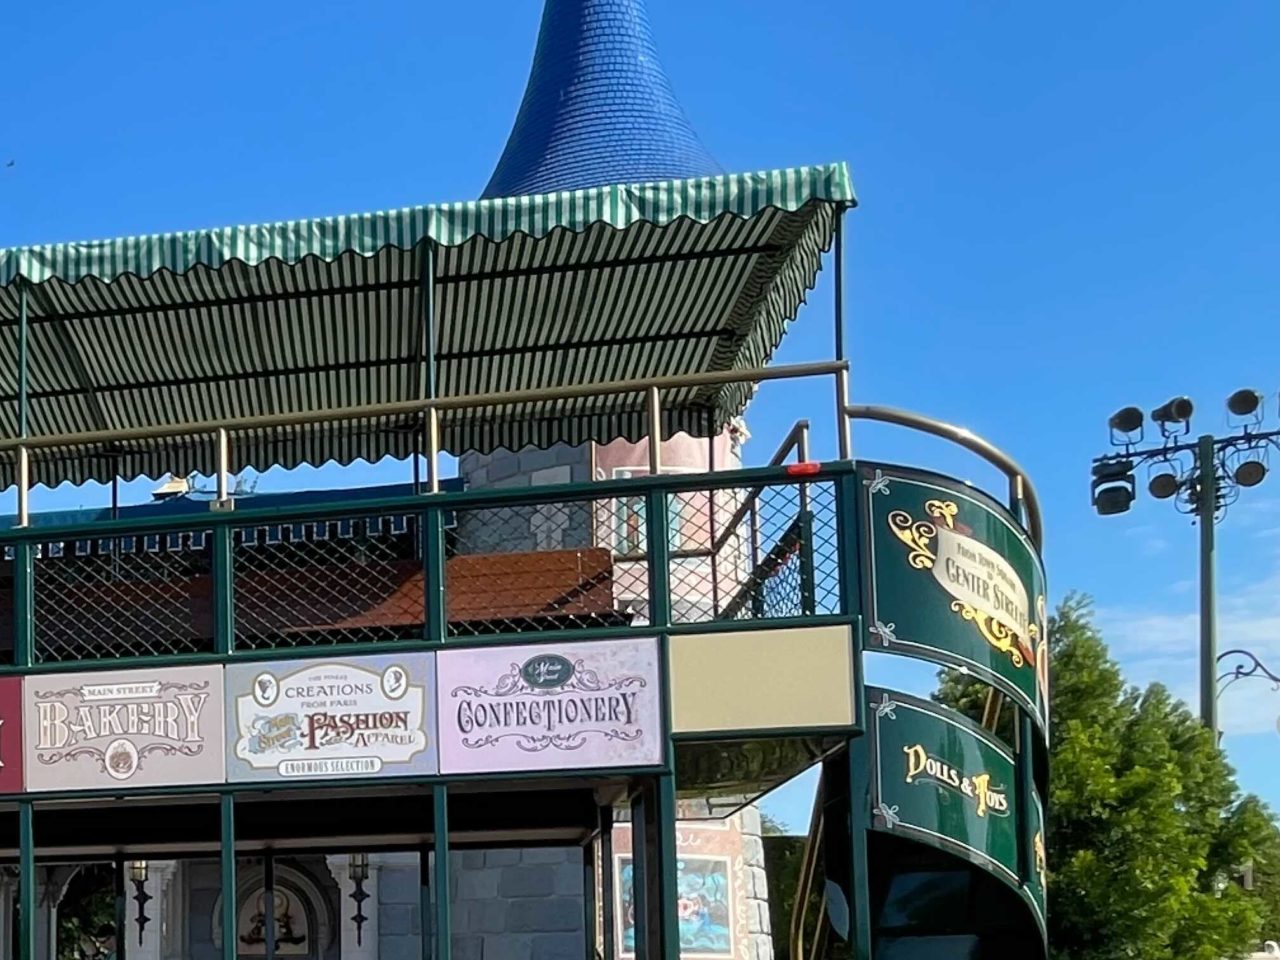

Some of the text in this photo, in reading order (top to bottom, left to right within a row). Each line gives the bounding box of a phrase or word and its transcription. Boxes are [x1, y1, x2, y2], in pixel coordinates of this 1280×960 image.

[945, 557, 990, 601] CENTER
[87, 684, 155, 697] MAIN STREET
[284, 683, 374, 699] CREATIONS
[330, 699, 357, 707] PARIS
[34, 692, 210, 750] BAKERY
[300, 711, 410, 750] FASHION
[457, 692, 637, 733] CONFECTIONERY
[285, 759, 375, 774] ENORMOUS SELECTION
[903, 744, 1009, 817] DOLLS & TOYS
